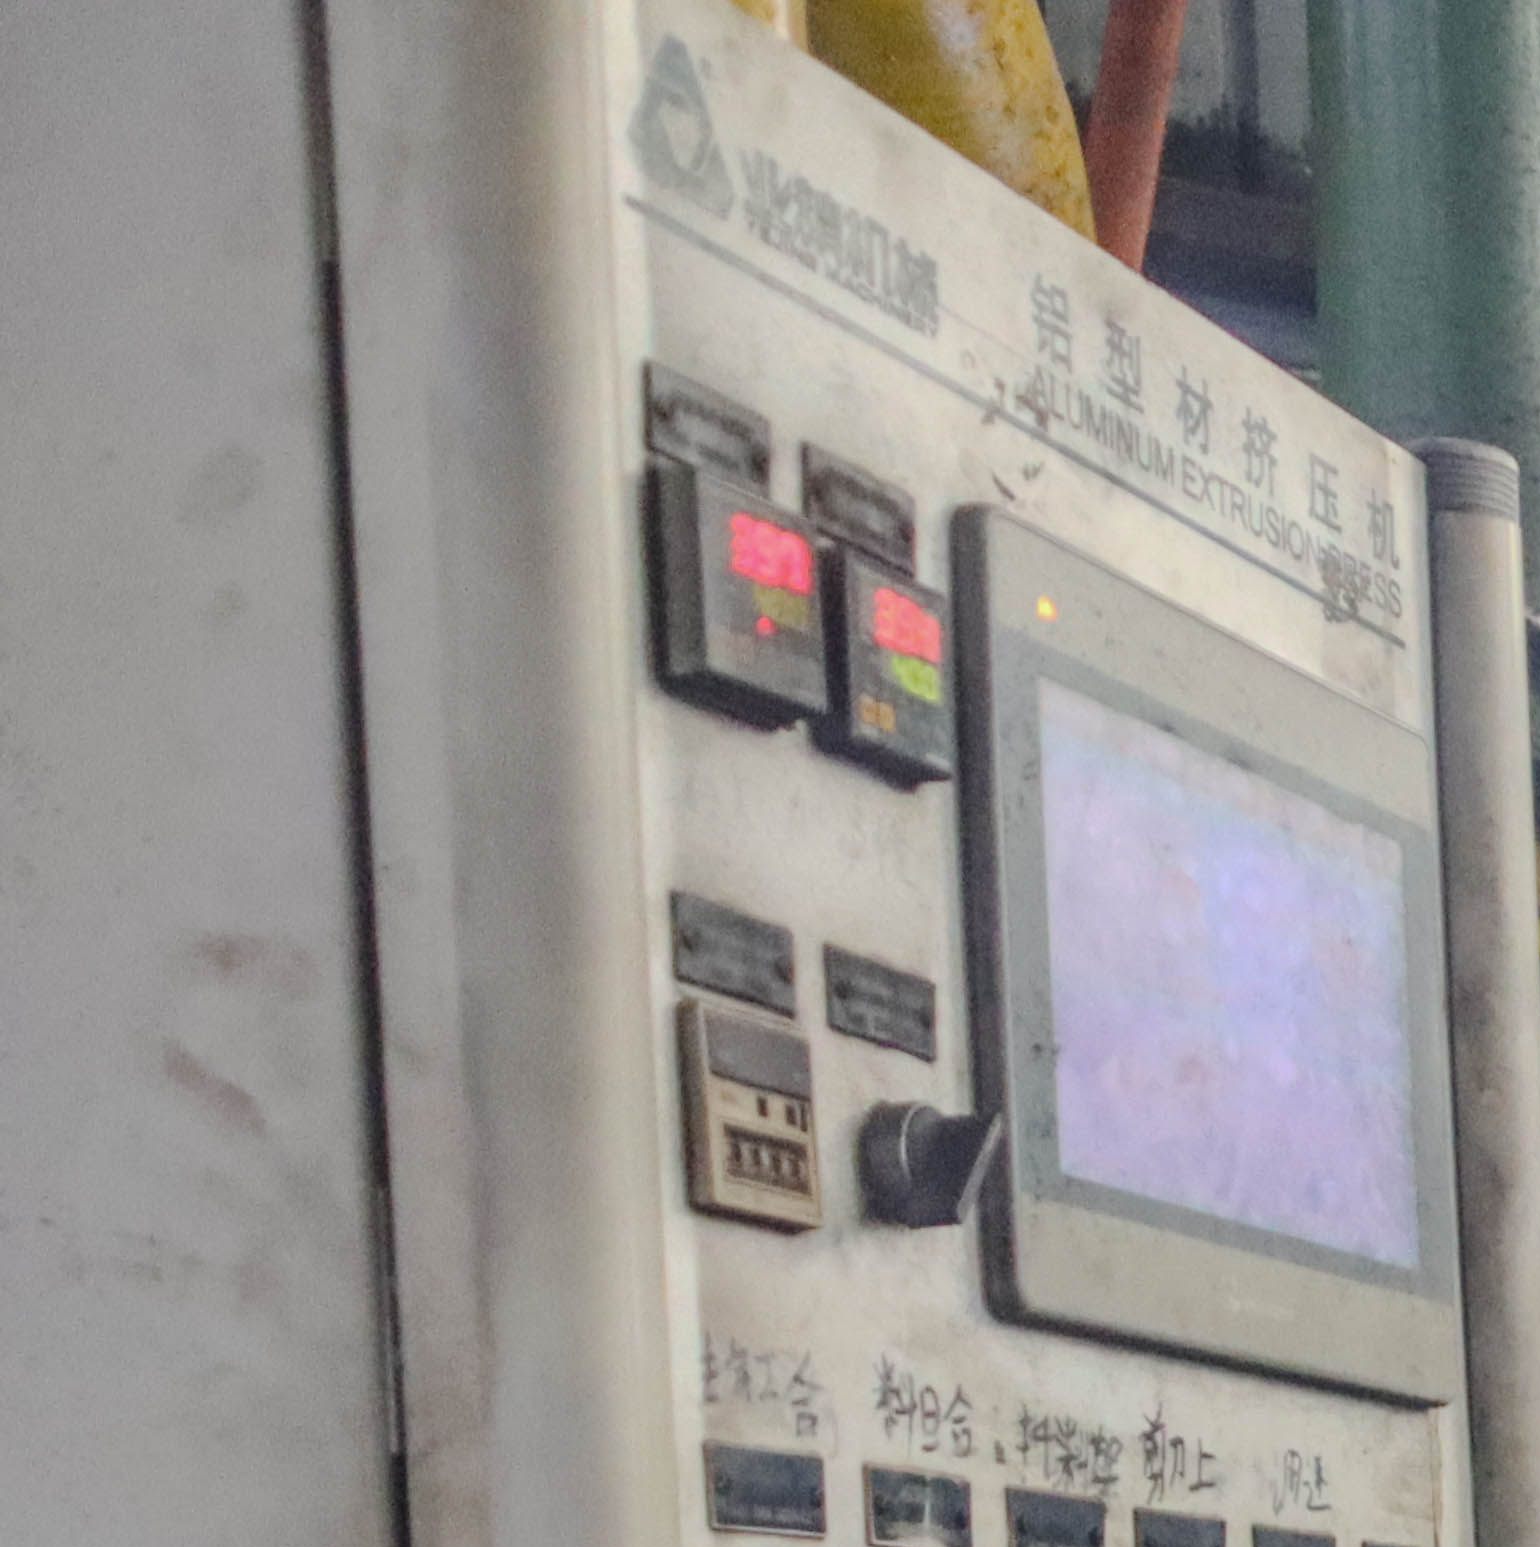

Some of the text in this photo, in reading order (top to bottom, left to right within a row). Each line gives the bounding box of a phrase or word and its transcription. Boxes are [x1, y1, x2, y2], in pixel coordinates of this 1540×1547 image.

[1024, 365, 1402, 619] ALUMINUM EXTRUSION PRESS
[1030, 271, 1400, 571] 铝型材挤压机
